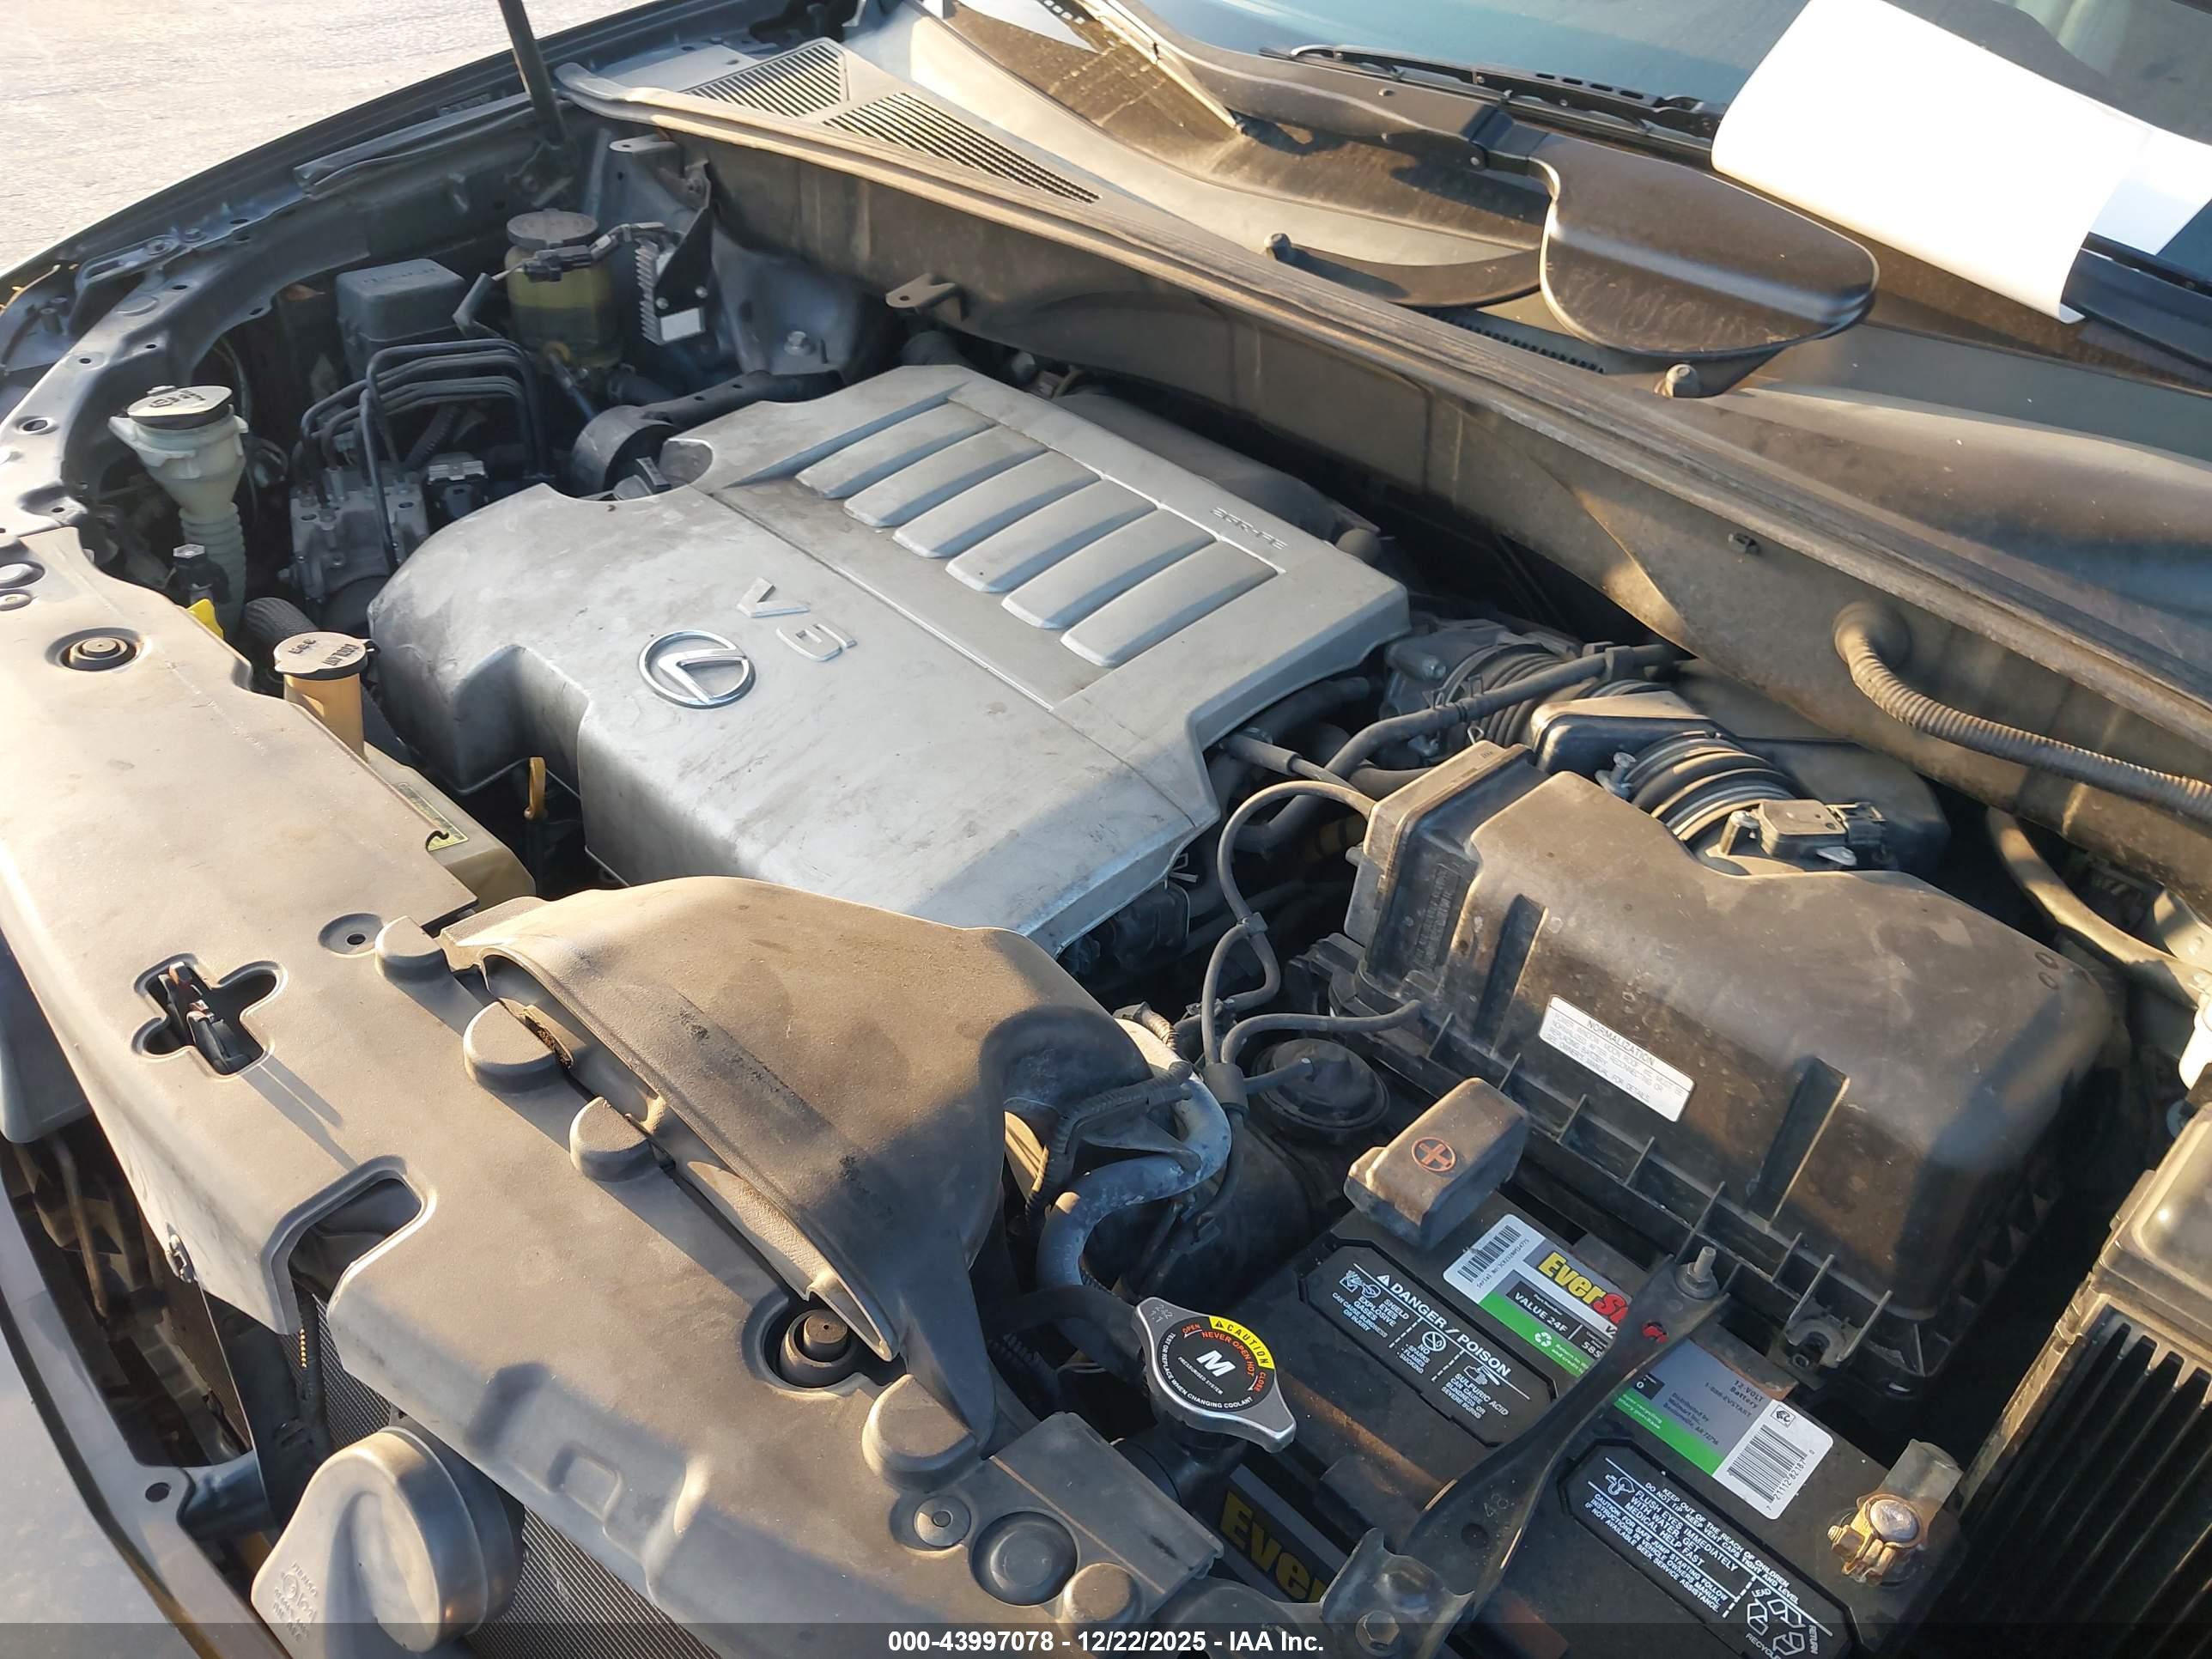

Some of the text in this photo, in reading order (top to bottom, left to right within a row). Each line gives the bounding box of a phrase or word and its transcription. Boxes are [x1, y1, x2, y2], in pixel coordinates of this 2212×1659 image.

[736, 577, 858, 662] V6
[1584, 1019, 1656, 1066] NORMALIZATION
[1333, 1292, 1388, 1338] CAN CAUSE BLINDNESS
[1354, 1301, 1377, 1321] GASES
[1357, 1296, 1396, 1327] EXPLOSIVE
[1379, 1304, 1400, 1319] EYES
[1382, 1299, 1409, 1319] SHIELD
[1516, 1292, 1567, 1331] VALUE 24F
[1182, 1323, 1201, 1334] OPEN
[1351, 1316, 1371, 1331] INJURY
[1388, 1283, 1447, 1328] DANGER
[1457, 1334, 1510, 1376] POISON
[1165, 1332, 1176, 1346] TEST
[1226, 1323, 1269, 1364] CAUTION
[1418, 1344, 1430, 1354] NO
[1582, 1341, 1603, 1358] 585
[1196, 1350, 1236, 1377] M
[1202, 1331, 1255, 1376] NEVER OPEN HOT
[1397, 1353, 1424, 1374] SMOKING
[1402, 1349, 1425, 1367] FLAMES
[1407, 1346, 1430, 1363] SPARKS
[1161, 1354, 1174, 1380] REPLACE
[1172, 1379, 1188, 1395] WHEN
[1205, 1380, 1224, 1395] SYSTEM
[1254, 1371, 1267, 1392] CLOSE
[1444, 1382, 1475, 1407] BLINDNESS
[1449, 1378, 1482, 1404] CAN CAUSE
[1454, 1374, 1508, 1415] SULFURIC ACID
[1187, 1393, 1223, 1408] CHANGING
[1224, 1396, 1253, 1408] COOLANT
[1442, 1387, 1483, 1419] SEVERE BURNS
[1729, 1385, 1759, 1409] Battery
[1633, 1410, 1661, 1429] purchase
[1637, 1404, 1662, 1424] recycling
[1588, 1499, 1633, 1534] INSTRUCTIONS
[1639, 1540, 1667, 1562] VEHICLE
[1622, 1503, 1705, 1565] MEDICAL HELP FAST
[1629, 1496, 1652, 1515] WITH
[1680, 1537, 1700, 1552] GET
[1634, 1491, 1738, 1571] FLUSH EYES IMMEDIATELY
[1592, 1508, 1606, 1520] NOT
[1606, 1516, 1638, 1546] AVAILABLE
[1637, 1544, 1655, 1559] SEEK
[1654, 1558, 1681, 1580] SERVICE
[1645, 1482, 1798, 1606] DO NOT TIP KEEP VENT CAPS TIGHT AND LEVEL
[1660, 1489, 1790, 1589] KEEP OUT OF THE REACH OF CHILDREN
[1622, 1516, 1635, 1528] FOR
[1635, 1527, 1652, 1541] SAFE
[1650, 1540, 1669, 1553] JUMP
[1669, 1554, 1701, 1580] STARTING
[1698, 1578, 1728, 1601] FOLLOW
[1751, 1588, 1771, 1598] LEAD
[1808, 1624, 1819, 1655] RETURN
